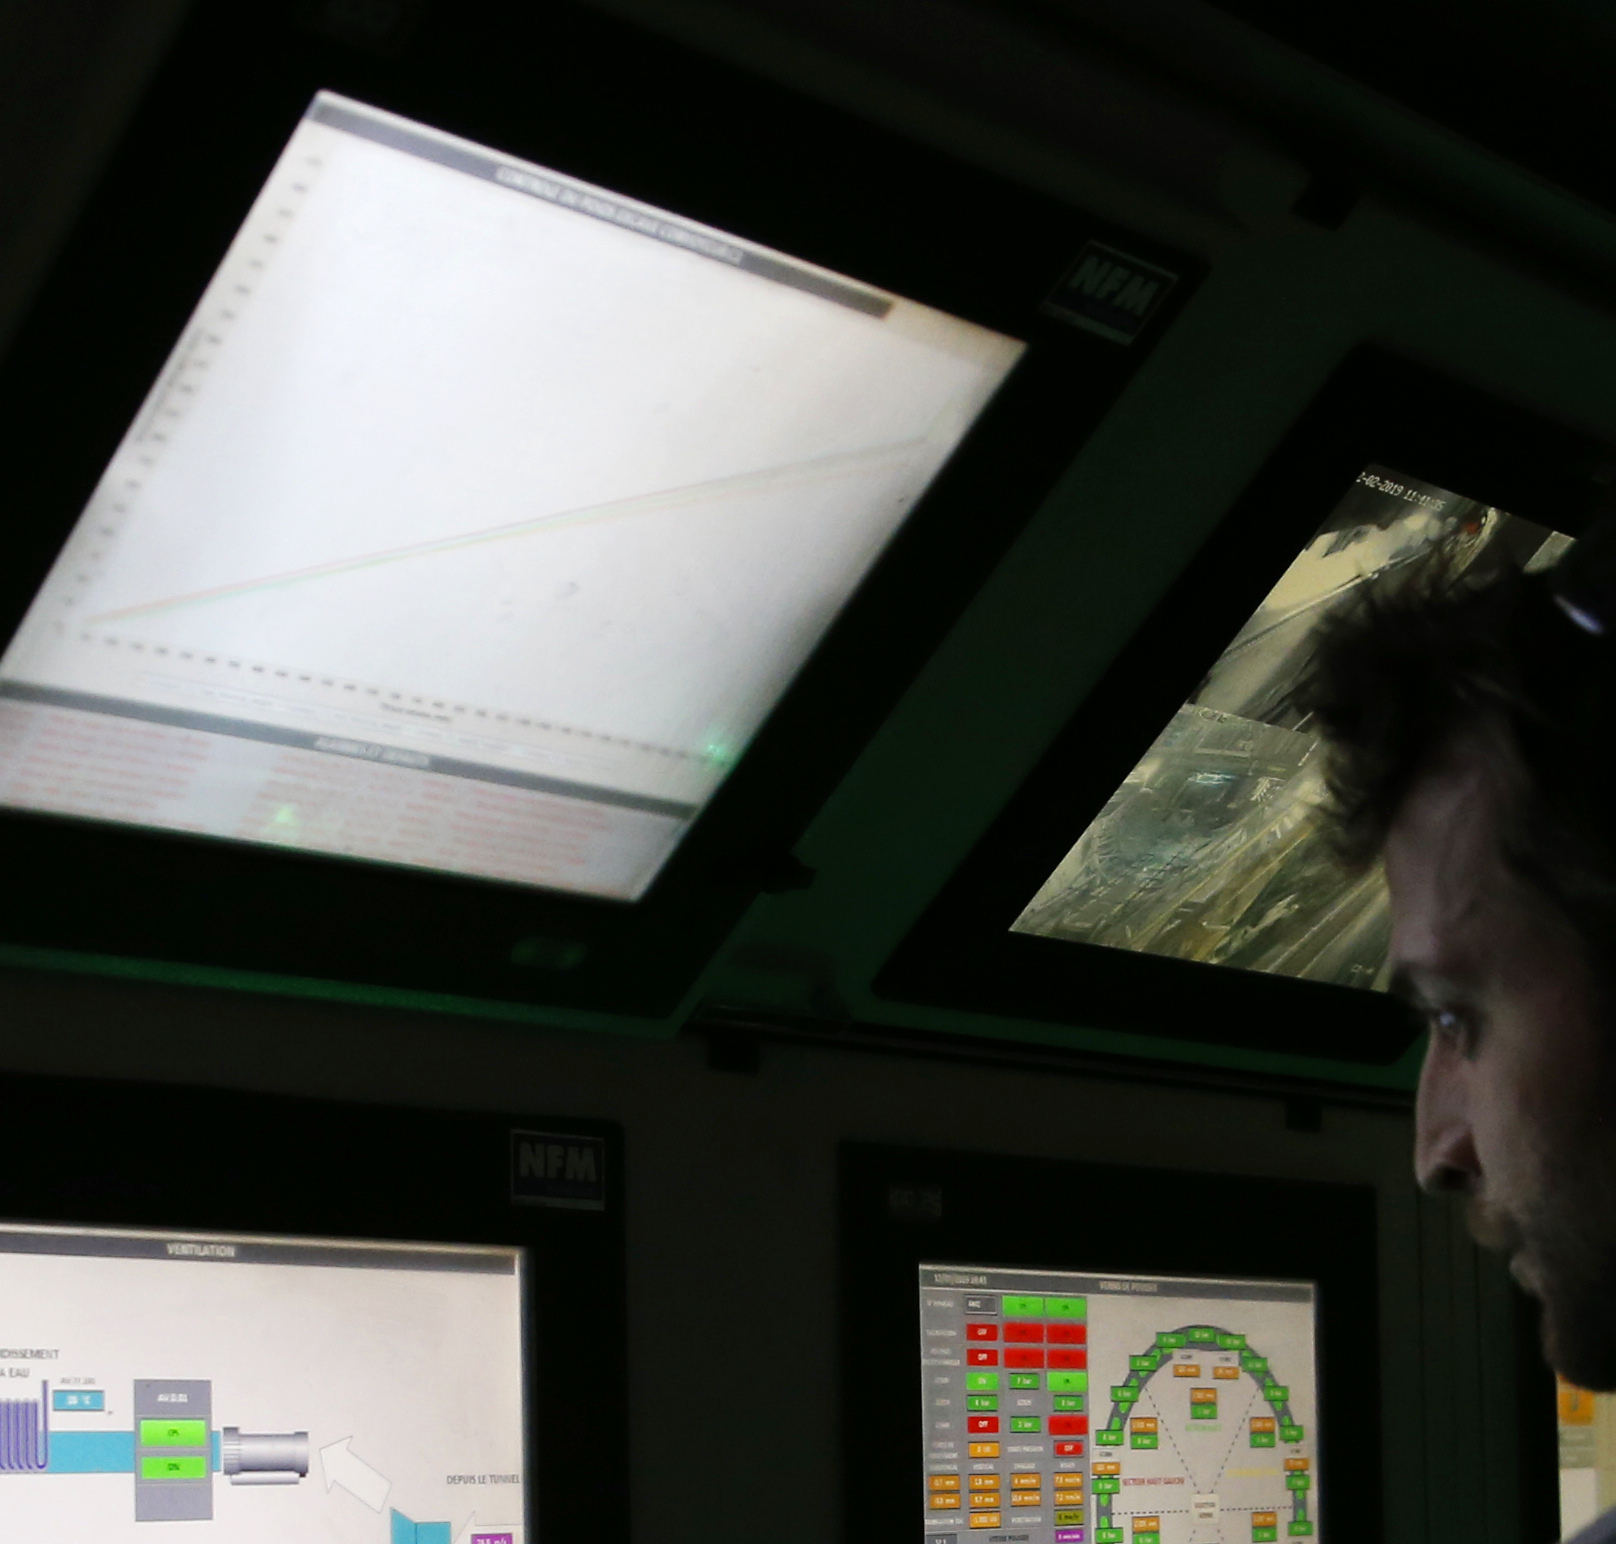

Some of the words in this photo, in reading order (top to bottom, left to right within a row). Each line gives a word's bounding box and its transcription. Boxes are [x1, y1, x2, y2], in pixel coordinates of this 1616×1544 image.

[1068, 254, 1160, 316] NFM
[518, 1140, 597, 1182] NFM
[447, 1474, 477, 1485] DEPUIS
[478, 1474, 487, 1485] LE
[489, 1474, 521, 1485] TUNNEL
